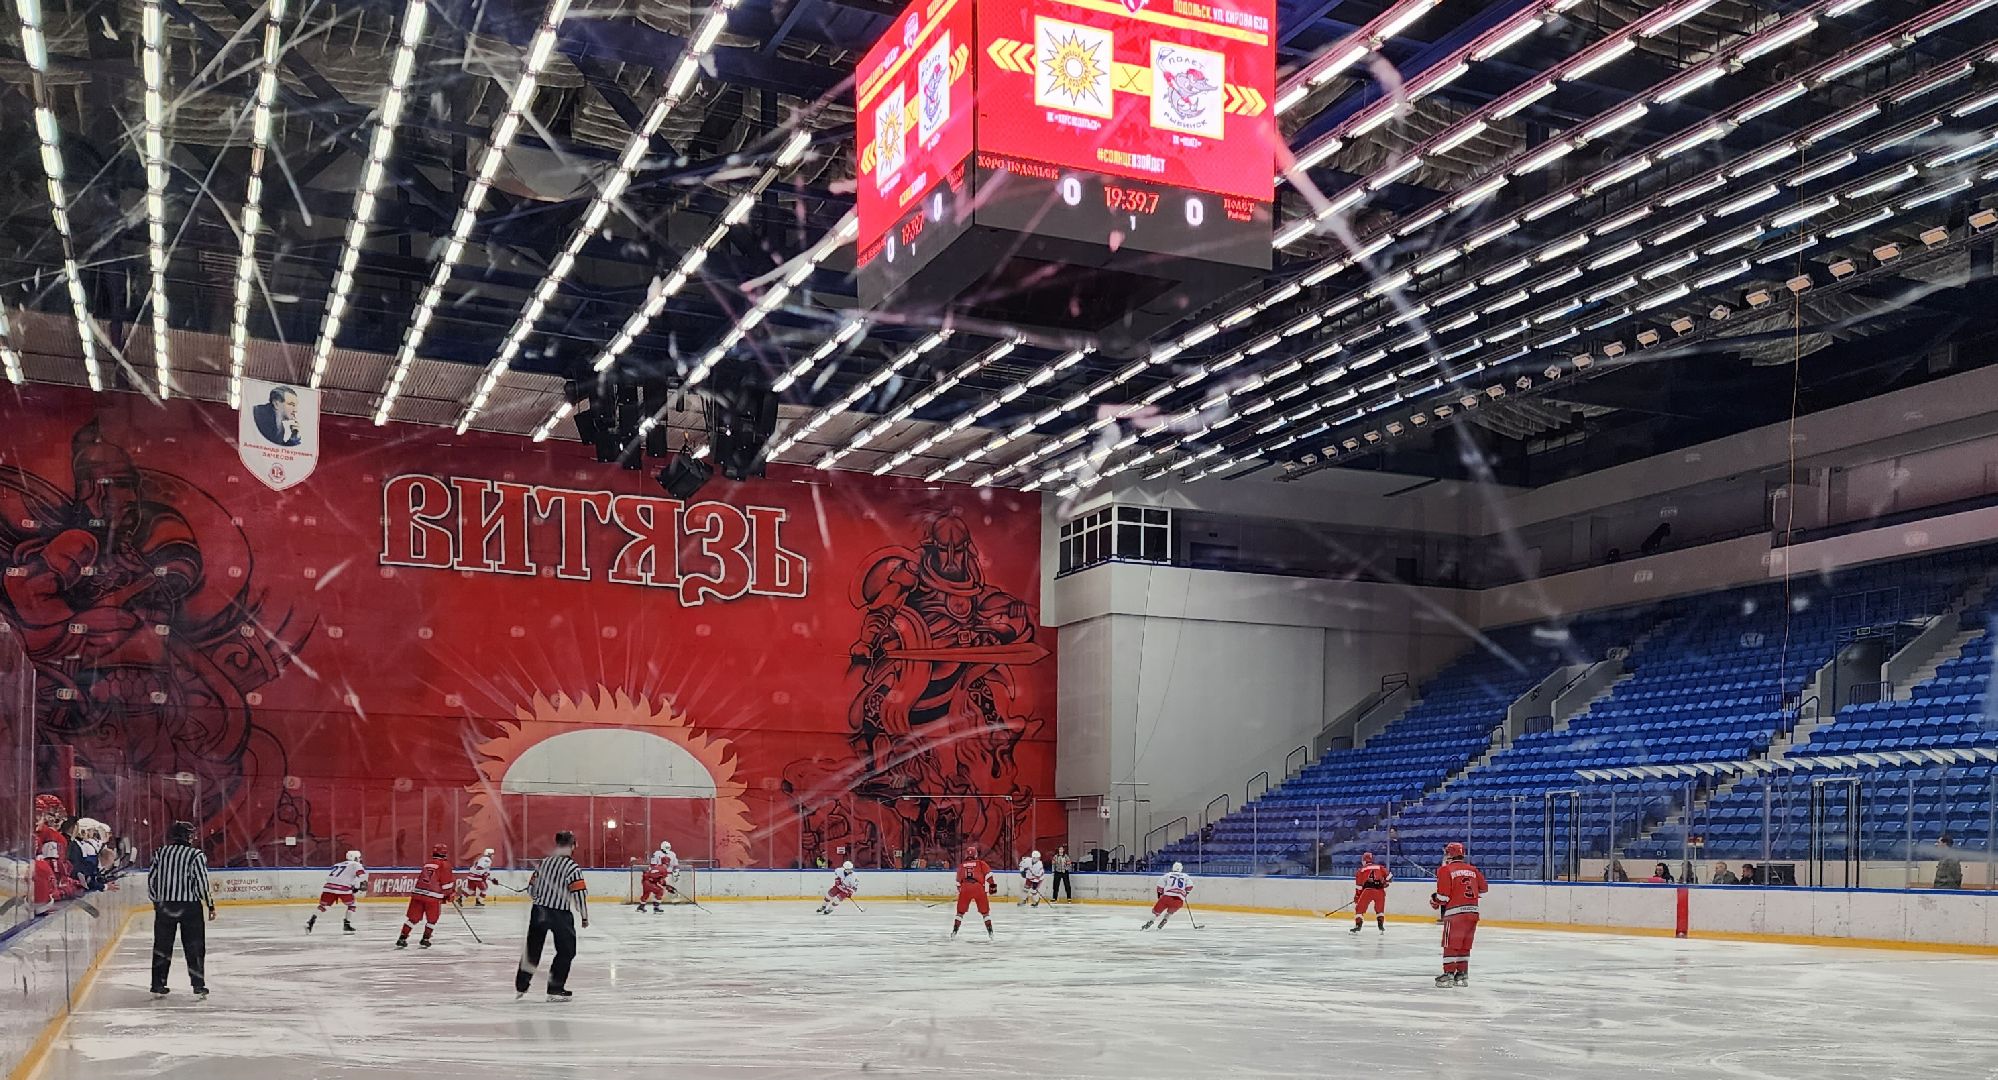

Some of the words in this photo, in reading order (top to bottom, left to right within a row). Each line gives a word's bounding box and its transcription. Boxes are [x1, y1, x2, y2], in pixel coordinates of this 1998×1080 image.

[1063, 177, 1081, 206] 0
[1104, 186, 1160, 214] 19:39.7
[934, 192, 943, 222] 0
[1186, 199, 1204, 226] 0
[1129, 215, 1136, 231] 1
[886, 236, 895, 263] 0
[379, 473, 807, 607] ВИТЯЗЬ
[329, 865, 347, 878] 27
[1461, 876, 1474, 899] 3
